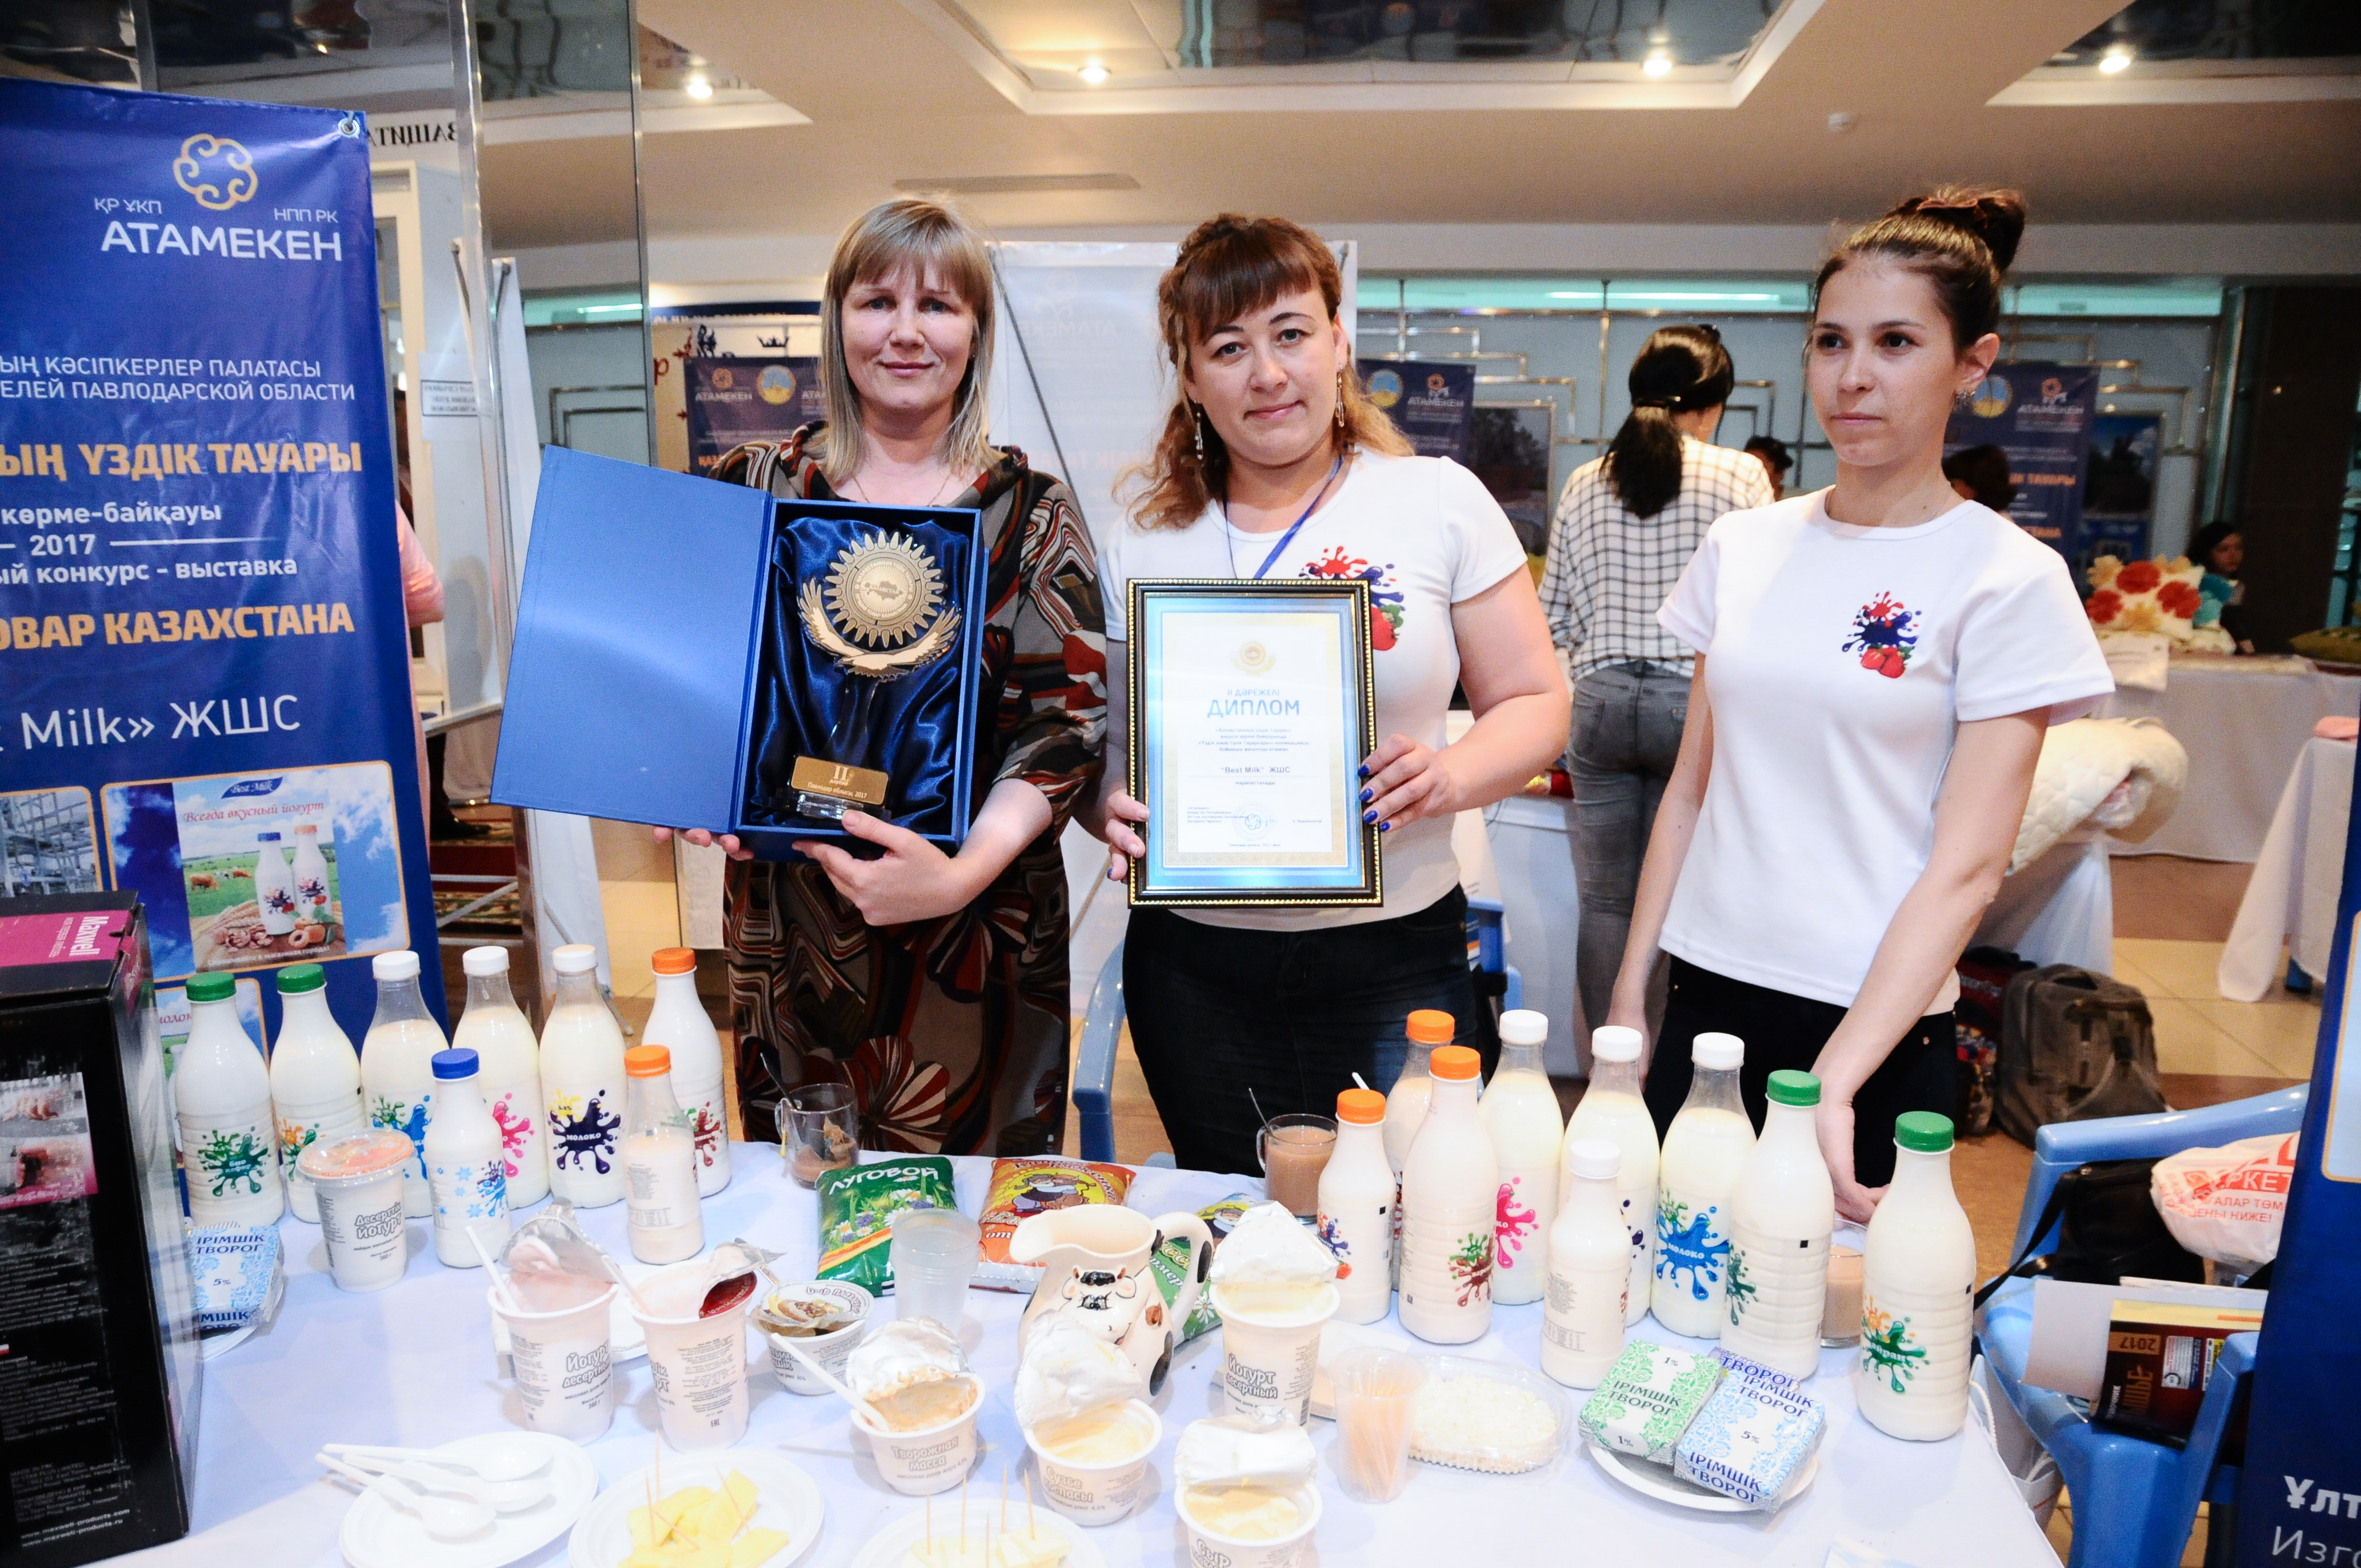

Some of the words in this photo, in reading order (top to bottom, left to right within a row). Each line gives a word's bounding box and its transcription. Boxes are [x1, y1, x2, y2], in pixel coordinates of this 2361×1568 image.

[95, 198, 119, 215] ҚР
[123, 199, 162, 214] ҰКП
[274, 208, 312, 222] НПП
[316, 210, 338, 223] РК
[101, 221, 342, 261] АТАМЕКЕН
[45, 357, 203, 377] КӘСІПКЕРЛЕР
[209, 360, 321, 378] ПАЛАТАСЫ
[72, 381, 253, 402] ПАВЛОДАРСКОЙ
[260, 384, 356, 400] ОБЛАСТИ
[78, 444, 200, 481] ҮЗДІК
[208, 442, 362, 474] ТАУАРЫ
[2, 502, 221, 530] көрме-байқауы
[30, 533, 96, 557] 2017
[37, 562, 149, 586] конкурс
[176, 558, 298, 579] выставка
[103, 602, 355, 645] КАЗАХСТАНА
[1207, 699, 1300, 718] ДИПЛОМ
[21, 707, 156, 750] Milk»
[169, 694, 301, 739] ЖШС
[808, 782, 832, 792] Павлодар
[183, 810, 224, 823] Всегда
[227, 804, 279, 821] вкусный
[282, 801, 324, 815] йогурт
[69, 916, 109, 956] Maxwell
[566, 1132, 601, 1141] МОЛОКО
[829, 1167, 938, 1195] ЛУГОВОЙ
[2231, 1211, 2272, 1223] НИЖЕ!
[195, 1243, 264, 1255] ТВОРОГ
[196, 1234, 265, 1245] ІРІМШІК
[1667, 1242, 1706, 1260] МОЛОКО
[2120, 1336, 2157, 1351] 2017
[1228, 1353, 1276, 1387] Йогурт
[1719, 1355, 1800, 1388] ТВОРОГ
[1608, 1390, 1677, 1416] ТВОРОГ
[1612, 1380, 1682, 1407] ІРІМШІК
[1738, 1385, 1810, 1418] ТВОРОГ
[1743, 1375, 1815, 1408] ІРІМШІК
[891, 1436, 959, 1461] Творожная
[1689, 1451, 1764, 1493] ІРІМШІК
[1689, 1467, 1760, 1504] ТВОРОГ
